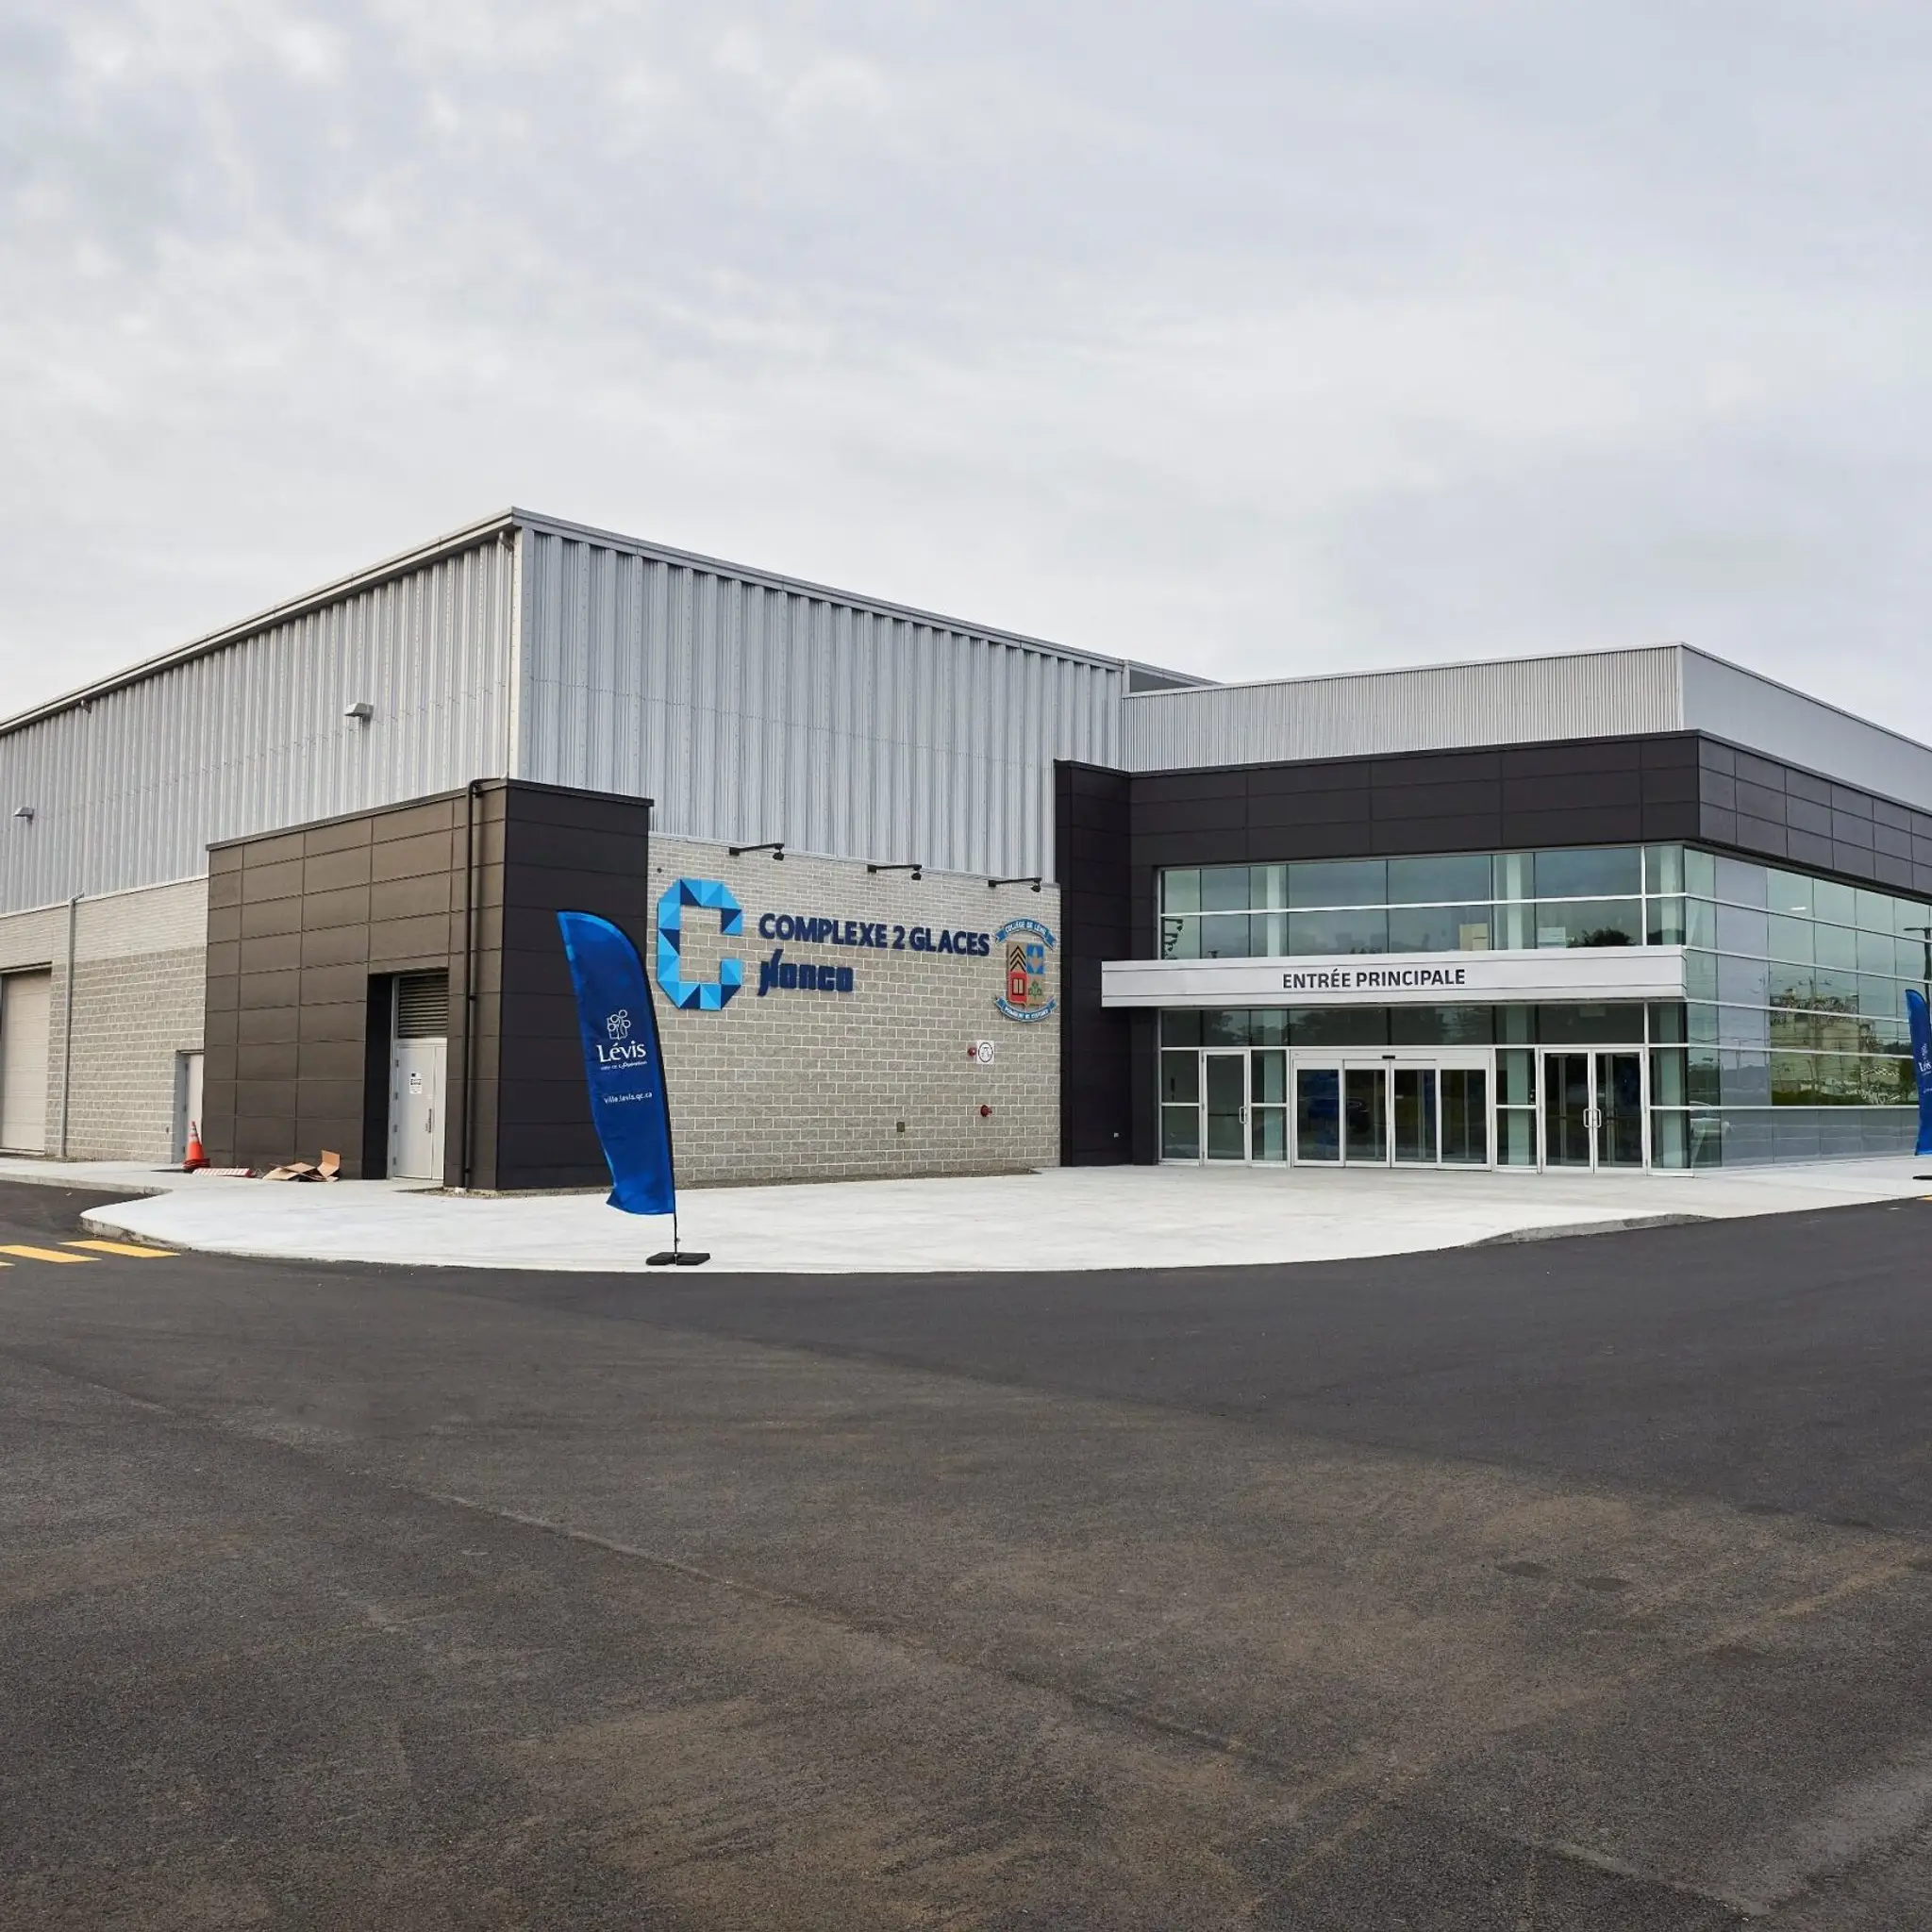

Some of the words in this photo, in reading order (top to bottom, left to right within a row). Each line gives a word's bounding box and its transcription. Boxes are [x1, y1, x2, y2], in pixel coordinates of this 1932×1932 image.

[758, 912, 888, 948] COMPLEXE
[891, 924, 906, 950] 2
[908, 926, 990, 956] GLACES
[1283, 968, 1351, 989] ENTRÉE
[1356, 969, 1466, 987] PRINCIPALE
[595, 1040, 647, 1063] Lévis
